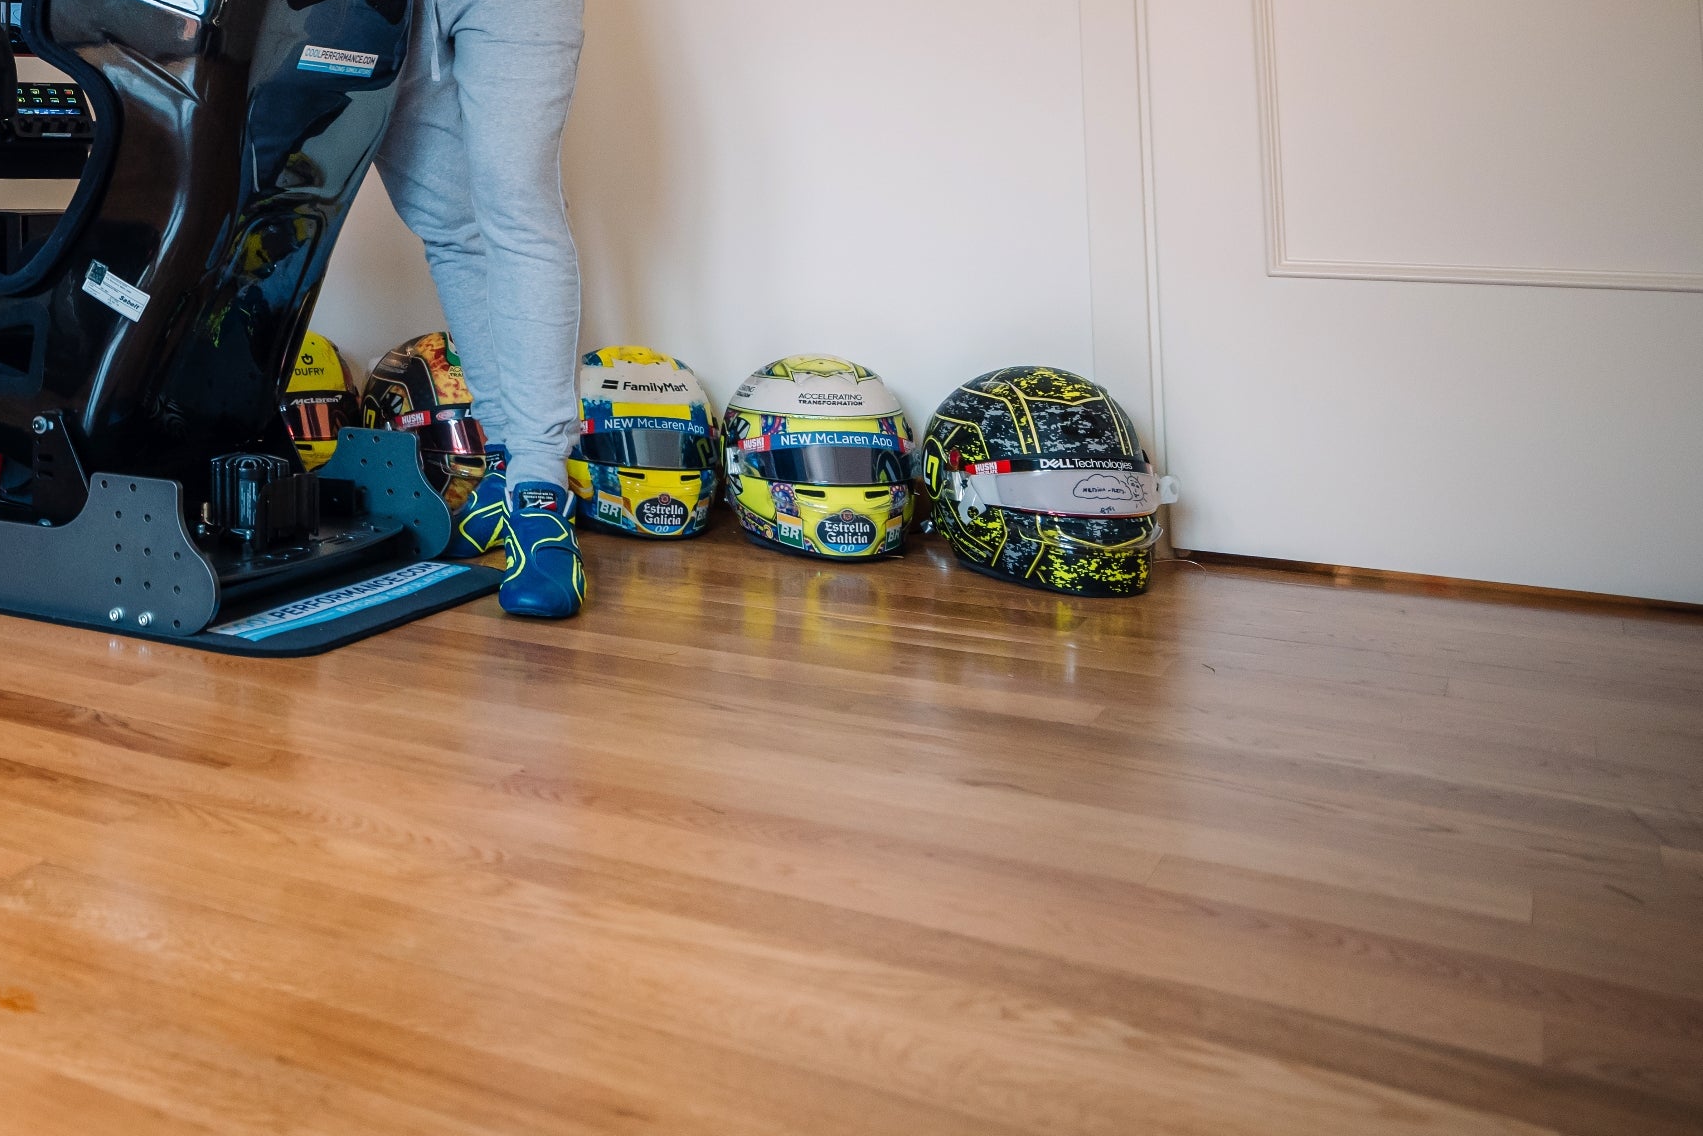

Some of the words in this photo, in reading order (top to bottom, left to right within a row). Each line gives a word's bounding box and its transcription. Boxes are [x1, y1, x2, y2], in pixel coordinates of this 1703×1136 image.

[118, 295, 140, 310] Sabelt
[294, 367, 325, 376] DUFRY
[622, 380, 689, 394] FamilyMart
[290, 396, 339, 406] McLaren
[798, 392, 863, 401] ACCELERATING
[401, 412, 424, 425] HUSKI
[604, 418, 634, 429] NEW
[637, 418, 685, 430] McLaren
[687, 424, 705, 435] App
[743, 437, 765, 450] HUSKI
[780, 434, 812, 446] NEW
[815, 433, 869, 445] McLaren
[872, 435, 893, 447] App
[974, 461, 998, 472] HUSKI
[1039, 459, 1074, 469] DELL
[1073, 458, 1133, 470] Technologies
[599, 502, 619, 518] BR
[643, 502, 684, 516] Estrella
[644, 513, 681, 526] Galicia
[780, 524, 800, 541] BR
[824, 520, 870, 533] Estrella
[826, 531, 868, 544] Galicia
